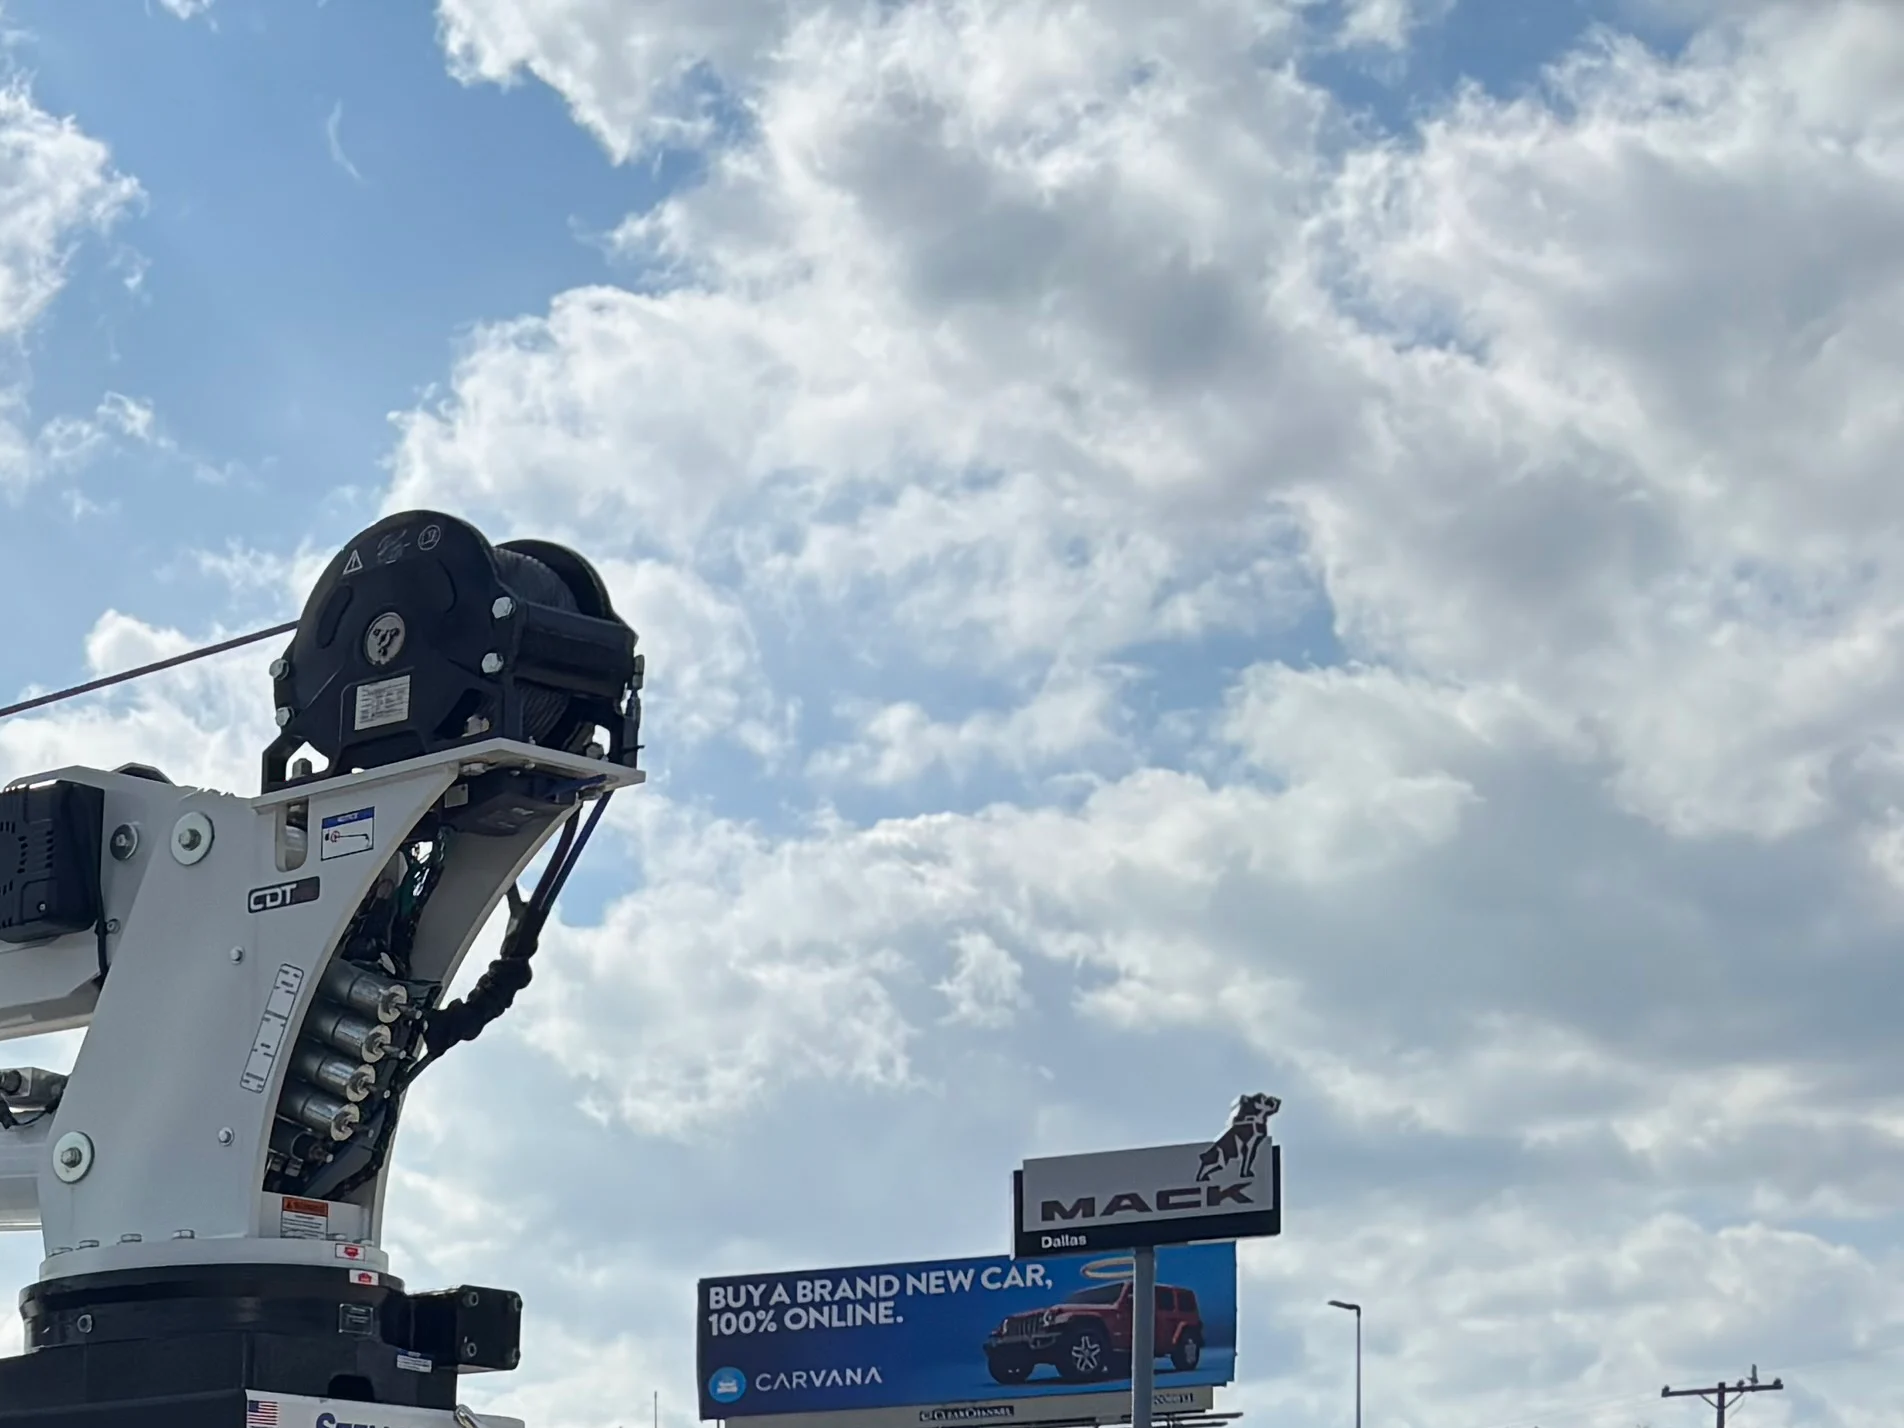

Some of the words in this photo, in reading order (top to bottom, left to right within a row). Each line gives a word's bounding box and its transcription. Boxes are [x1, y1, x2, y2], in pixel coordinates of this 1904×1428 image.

[1040, 1181, 1255, 1222] MACK
[1041, 1233, 1087, 1249] Dallas
[709, 1283, 768, 1310] BUY
[769, 1281, 792, 1307] A
[796, 1273, 900, 1304] BRAND
[906, 1267, 976, 1296] NEW
[980, 1263, 1054, 1291] CAR,
[708, 1309, 777, 1336] 100%
[783, 1300, 904, 1331] ONLINE.
[755, 1365, 883, 1392] CARVANA
